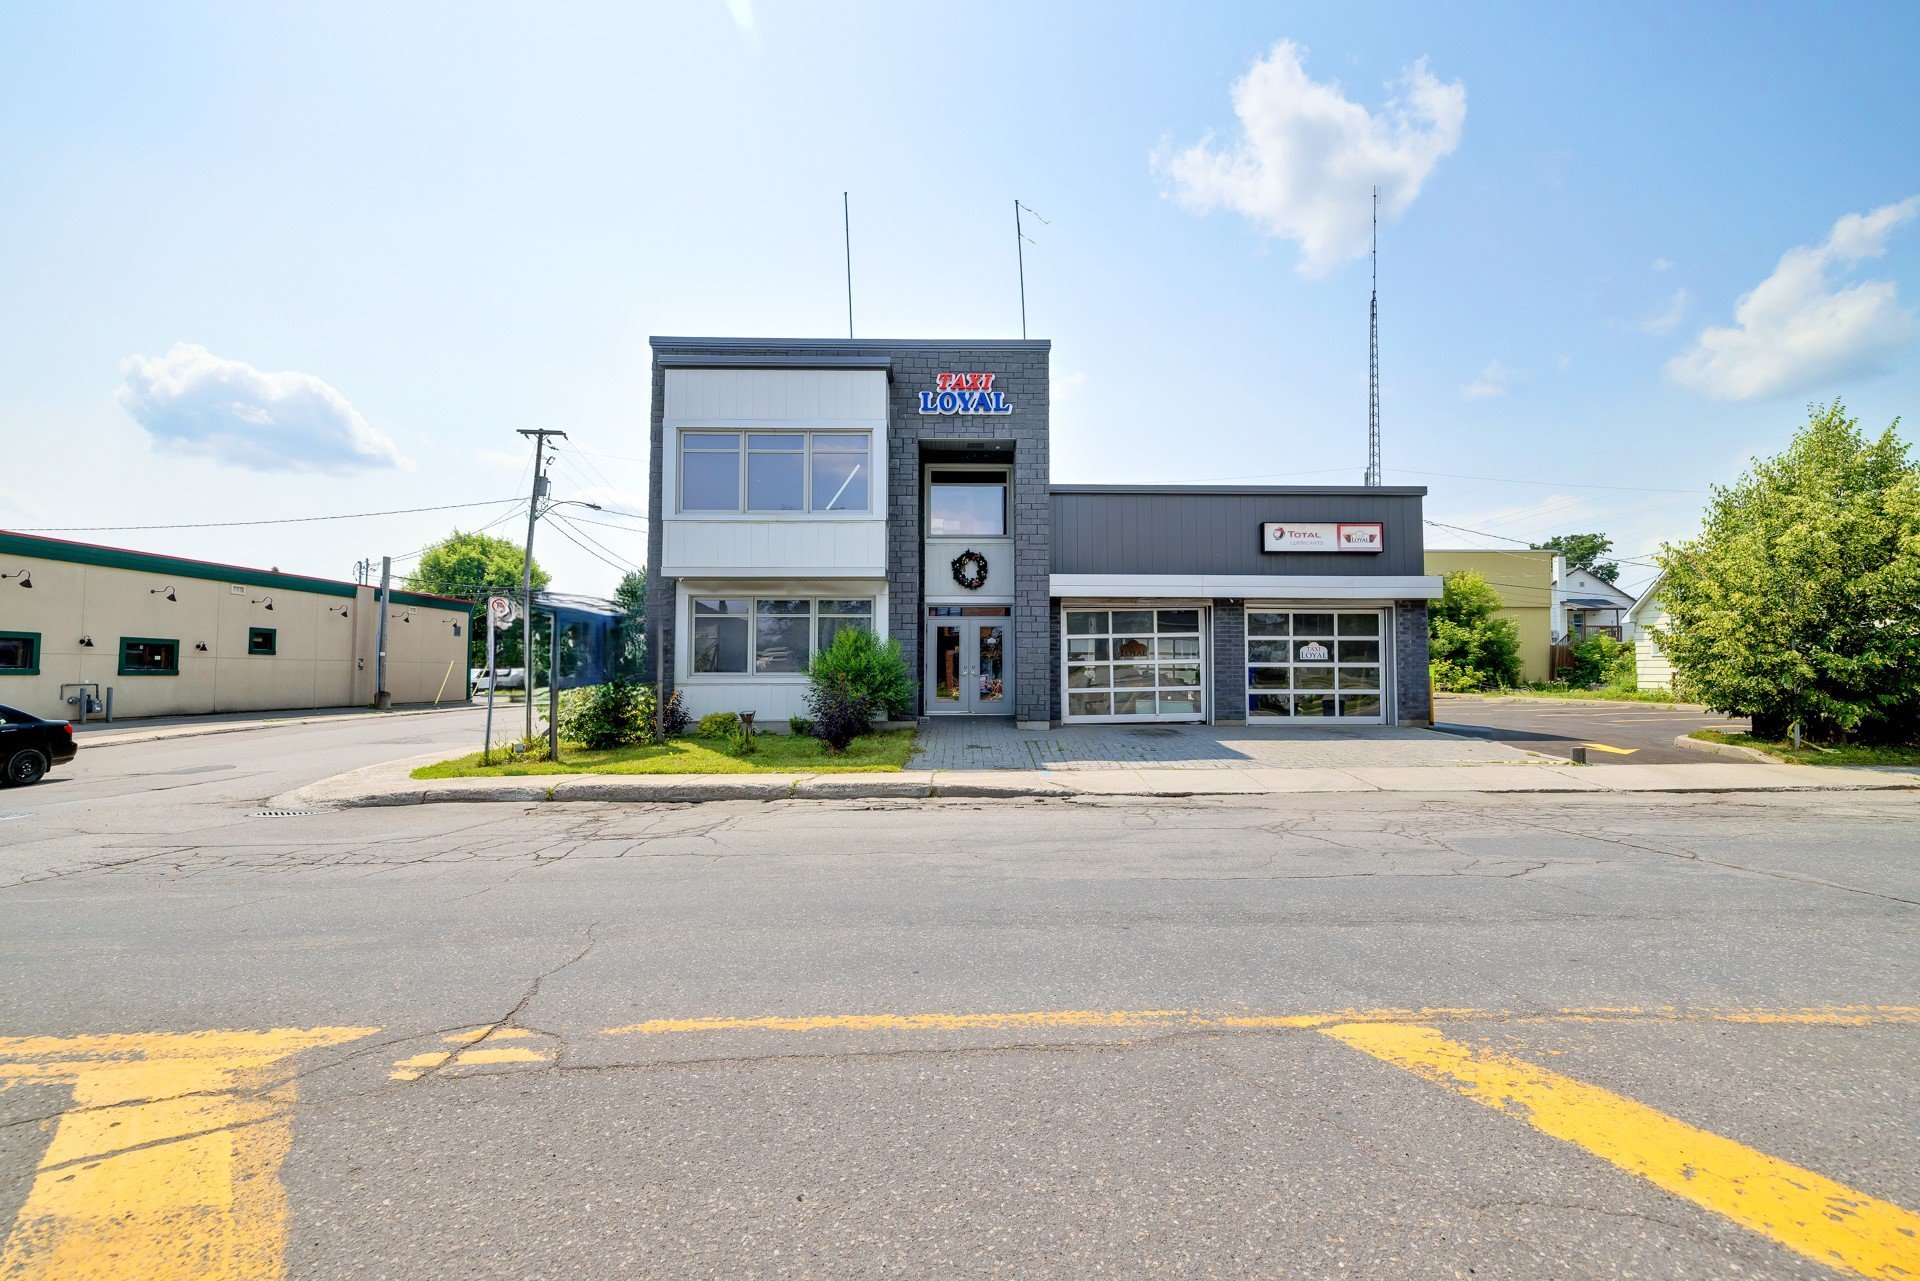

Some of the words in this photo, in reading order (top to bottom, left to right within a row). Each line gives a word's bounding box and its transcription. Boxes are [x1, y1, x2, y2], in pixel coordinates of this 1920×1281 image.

[937, 373, 994, 391] TAXI
[920, 391, 1012, 414] LOYAL
[1288, 530, 1321, 538] TOTAL
[1120, 649, 1147, 657] LOYAL
